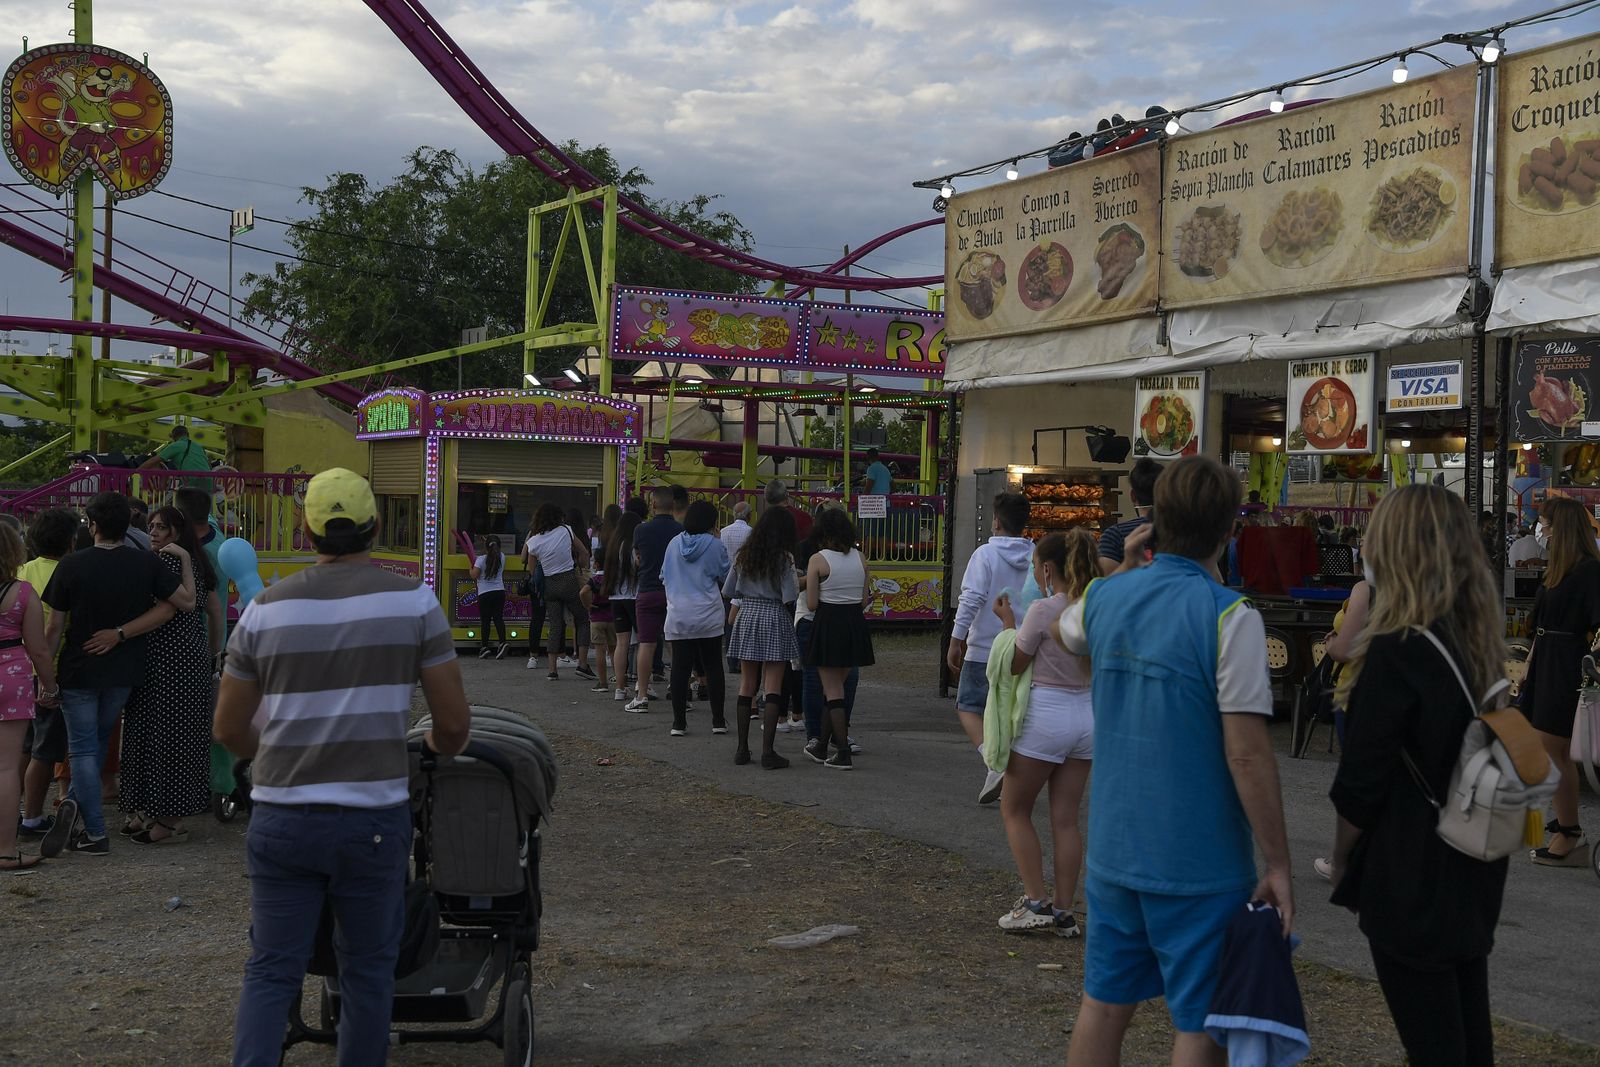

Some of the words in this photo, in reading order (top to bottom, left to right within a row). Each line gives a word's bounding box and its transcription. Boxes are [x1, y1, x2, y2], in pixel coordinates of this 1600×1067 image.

[1529, 50, 1600, 95] Ració
[1379, 90, 1445, 129] Ración
[1278, 117, 1336, 152] Ración
[1363, 123, 1461, 168] Pescaditos
[1176, 140, 1227, 173] Ración
[1233, 140, 1249, 160] de
[1263, 148, 1351, 184] Calamares
[1092, 171, 1140, 198] Secreto
[1170, 179, 1203, 202] Sepia
[1206, 168, 1254, 199] Plancha
[956, 200, 1004, 229] Chuletón
[1021, 193, 1060, 215] Conejo
[1063, 190, 1070, 205] a
[1094, 193, 1138, 223] Ibérico
[1016, 222, 1026, 240] la
[1030, 211, 1076, 241] Parrilla
[958, 234, 971, 251] de
[1544, 341, 1578, 355] Pollo
[1553, 355, 1592, 363] PATATAS
[1292, 361, 1328, 378] CHULETAS
[1331, 360, 1341, 375] DE
[1345, 358, 1368, 374] CERDO
[1543, 362, 1590, 370] PIMIENTOS
[1140, 376, 1174, 390] ENSALADA
[1177, 375, 1200, 390] MIXTA
[1400, 377, 1449, 396] VISA
[1397, 398, 1413, 407] CON
[1416, 396, 1449, 406] TARJETA
[367, 402, 387, 433] SUPER
[466, 402, 538, 431] SUPER
